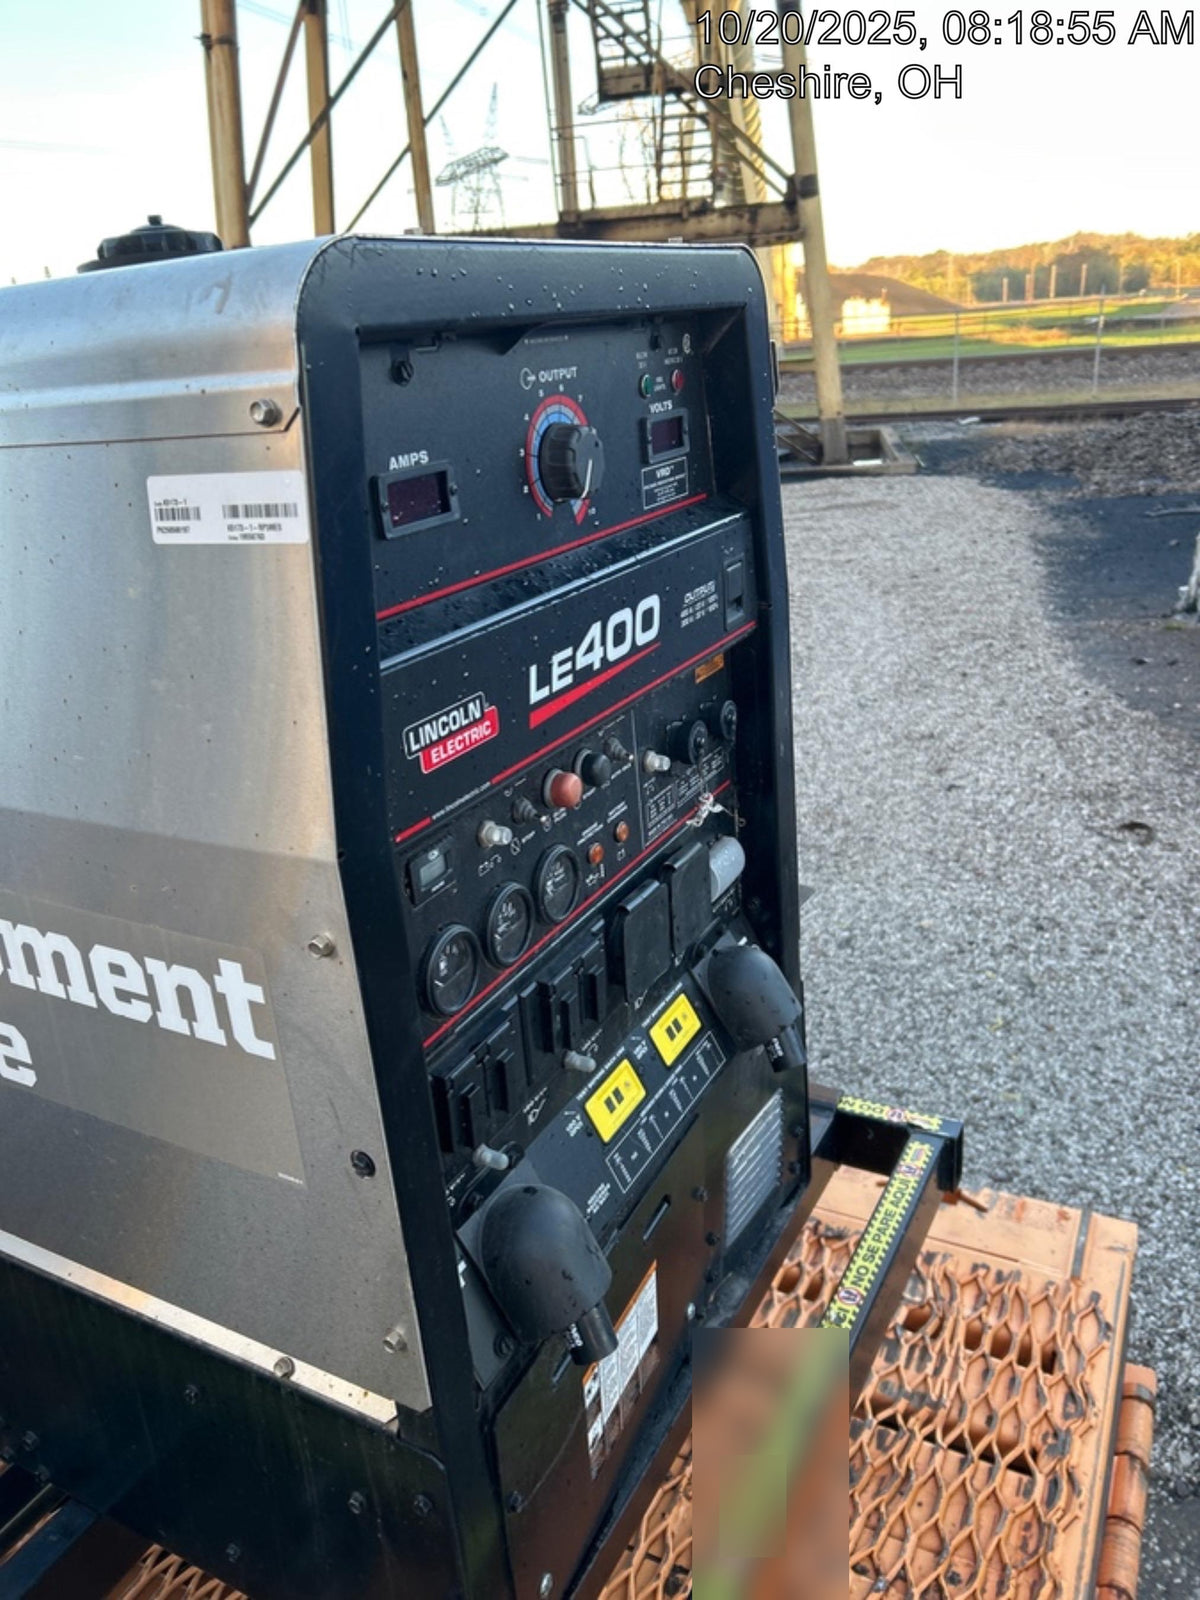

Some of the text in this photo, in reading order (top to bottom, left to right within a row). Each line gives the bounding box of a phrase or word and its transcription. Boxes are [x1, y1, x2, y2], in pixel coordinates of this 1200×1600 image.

[538, 366, 578, 383] OUTPUT
[648, 399, 673, 414] VOLTS
[388, 449, 430, 471] AMPS
[529, 593, 661, 705] LE400
[408, 698, 482, 753] LINCOLN
[430, 720, 492, 764] ELECTRIC
[0, 917, 277, 1061] ment
[851, 1265, 870, 1287] NO
[861, 1244, 880, 1264] SE
[872, 1207, 897, 1243] PARE
